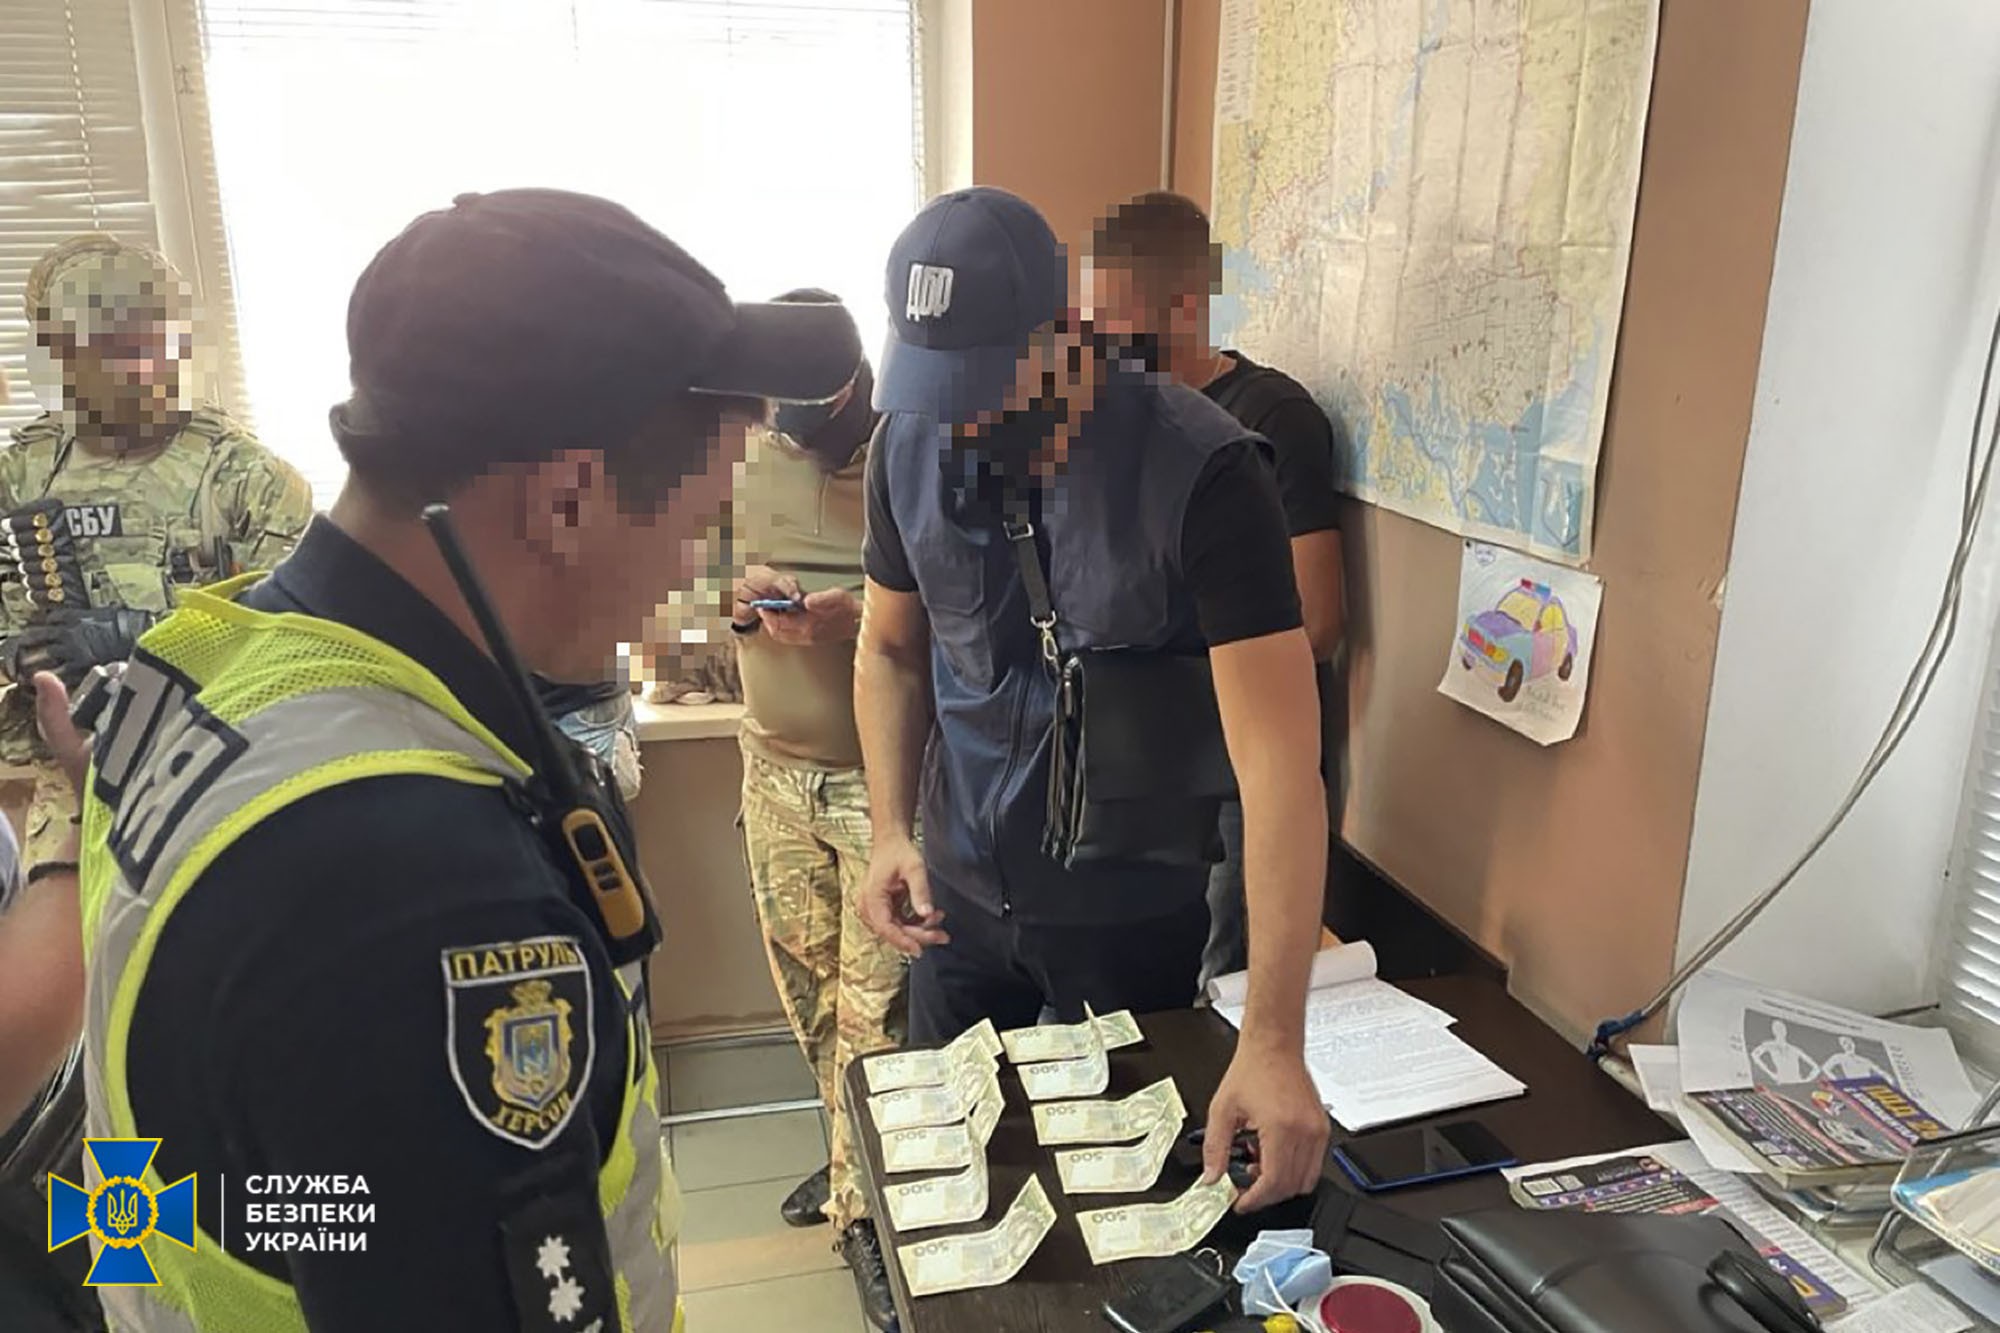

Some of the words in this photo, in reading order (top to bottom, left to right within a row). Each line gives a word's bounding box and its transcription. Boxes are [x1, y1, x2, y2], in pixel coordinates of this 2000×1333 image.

[906, 263, 954, 322] ДБР
[65, 506, 115, 537] СБУ
[453, 940, 579, 980] ПАТРУЛЬ
